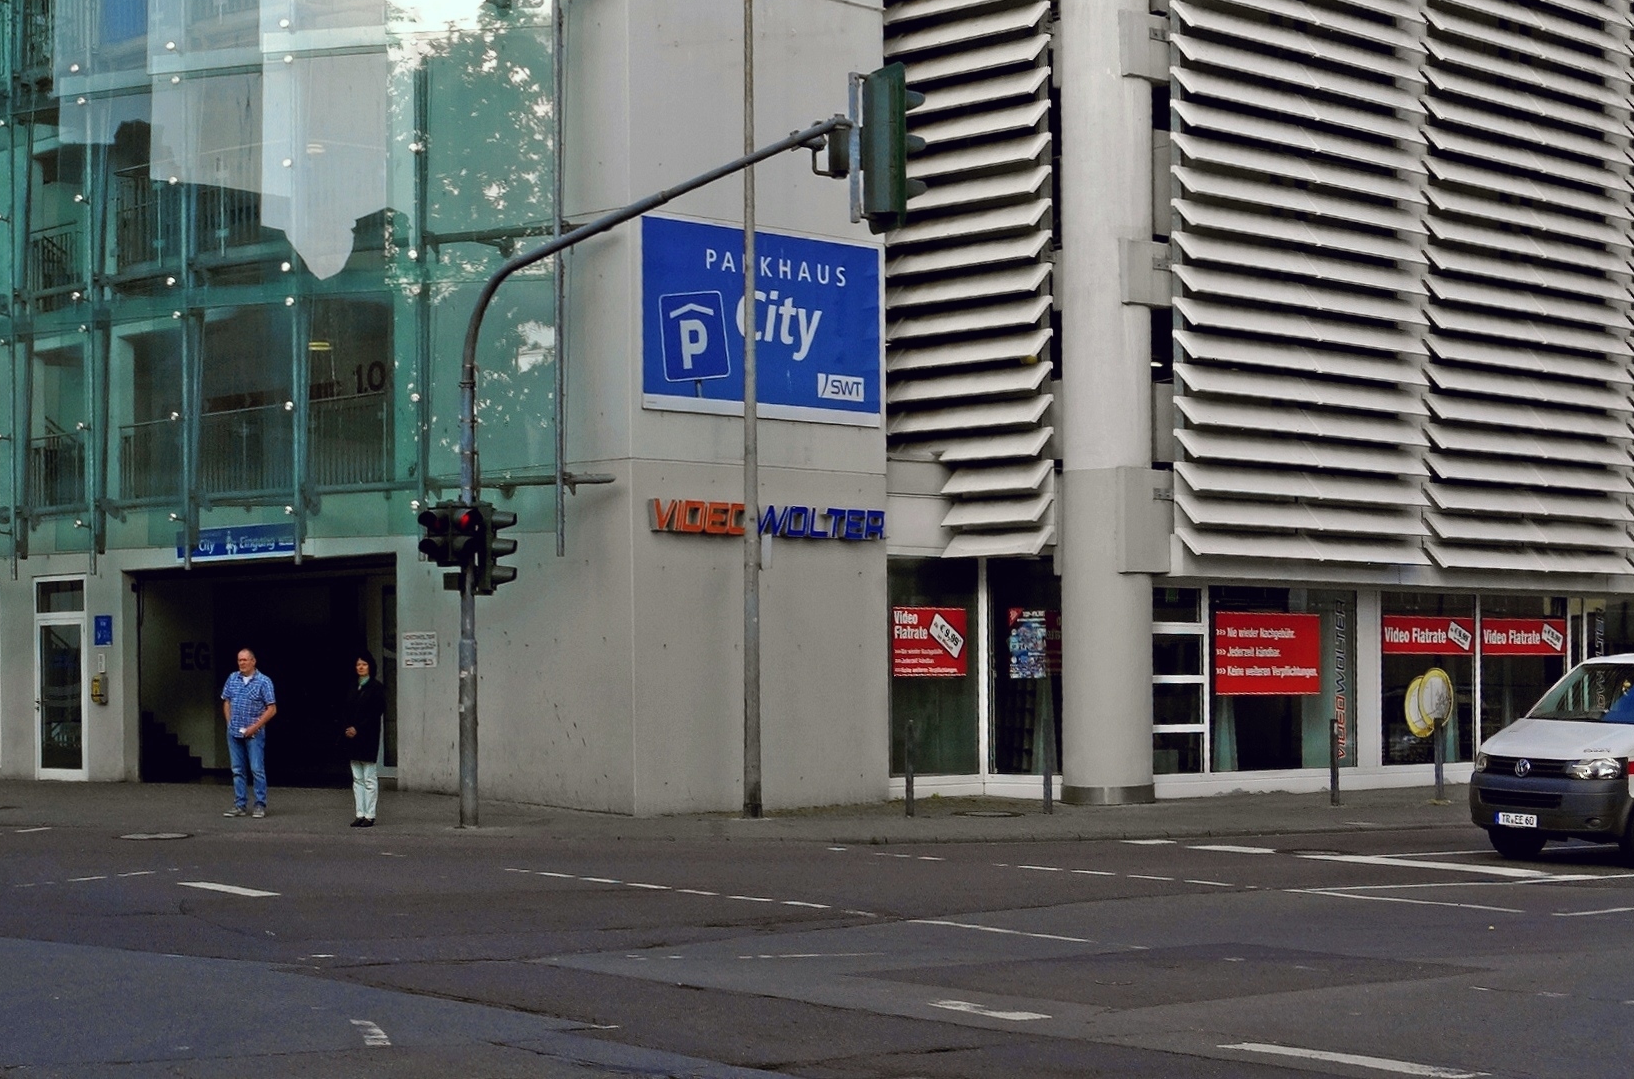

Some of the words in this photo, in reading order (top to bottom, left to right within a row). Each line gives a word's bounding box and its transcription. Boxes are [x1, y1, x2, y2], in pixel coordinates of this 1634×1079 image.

[705, 248, 847, 287] PAKHAUS
[735, 290, 823, 362] City
[830, 379, 863, 397] SWT
[758, 505, 886, 540] WOLTER
[894, 610, 918, 625] Video
[1384, 626, 1410, 643] Video
[1412, 627, 1447, 644] Flatrate
[1483, 628, 1507, 645] Video
[1508, 629, 1541, 645] Flatrate
